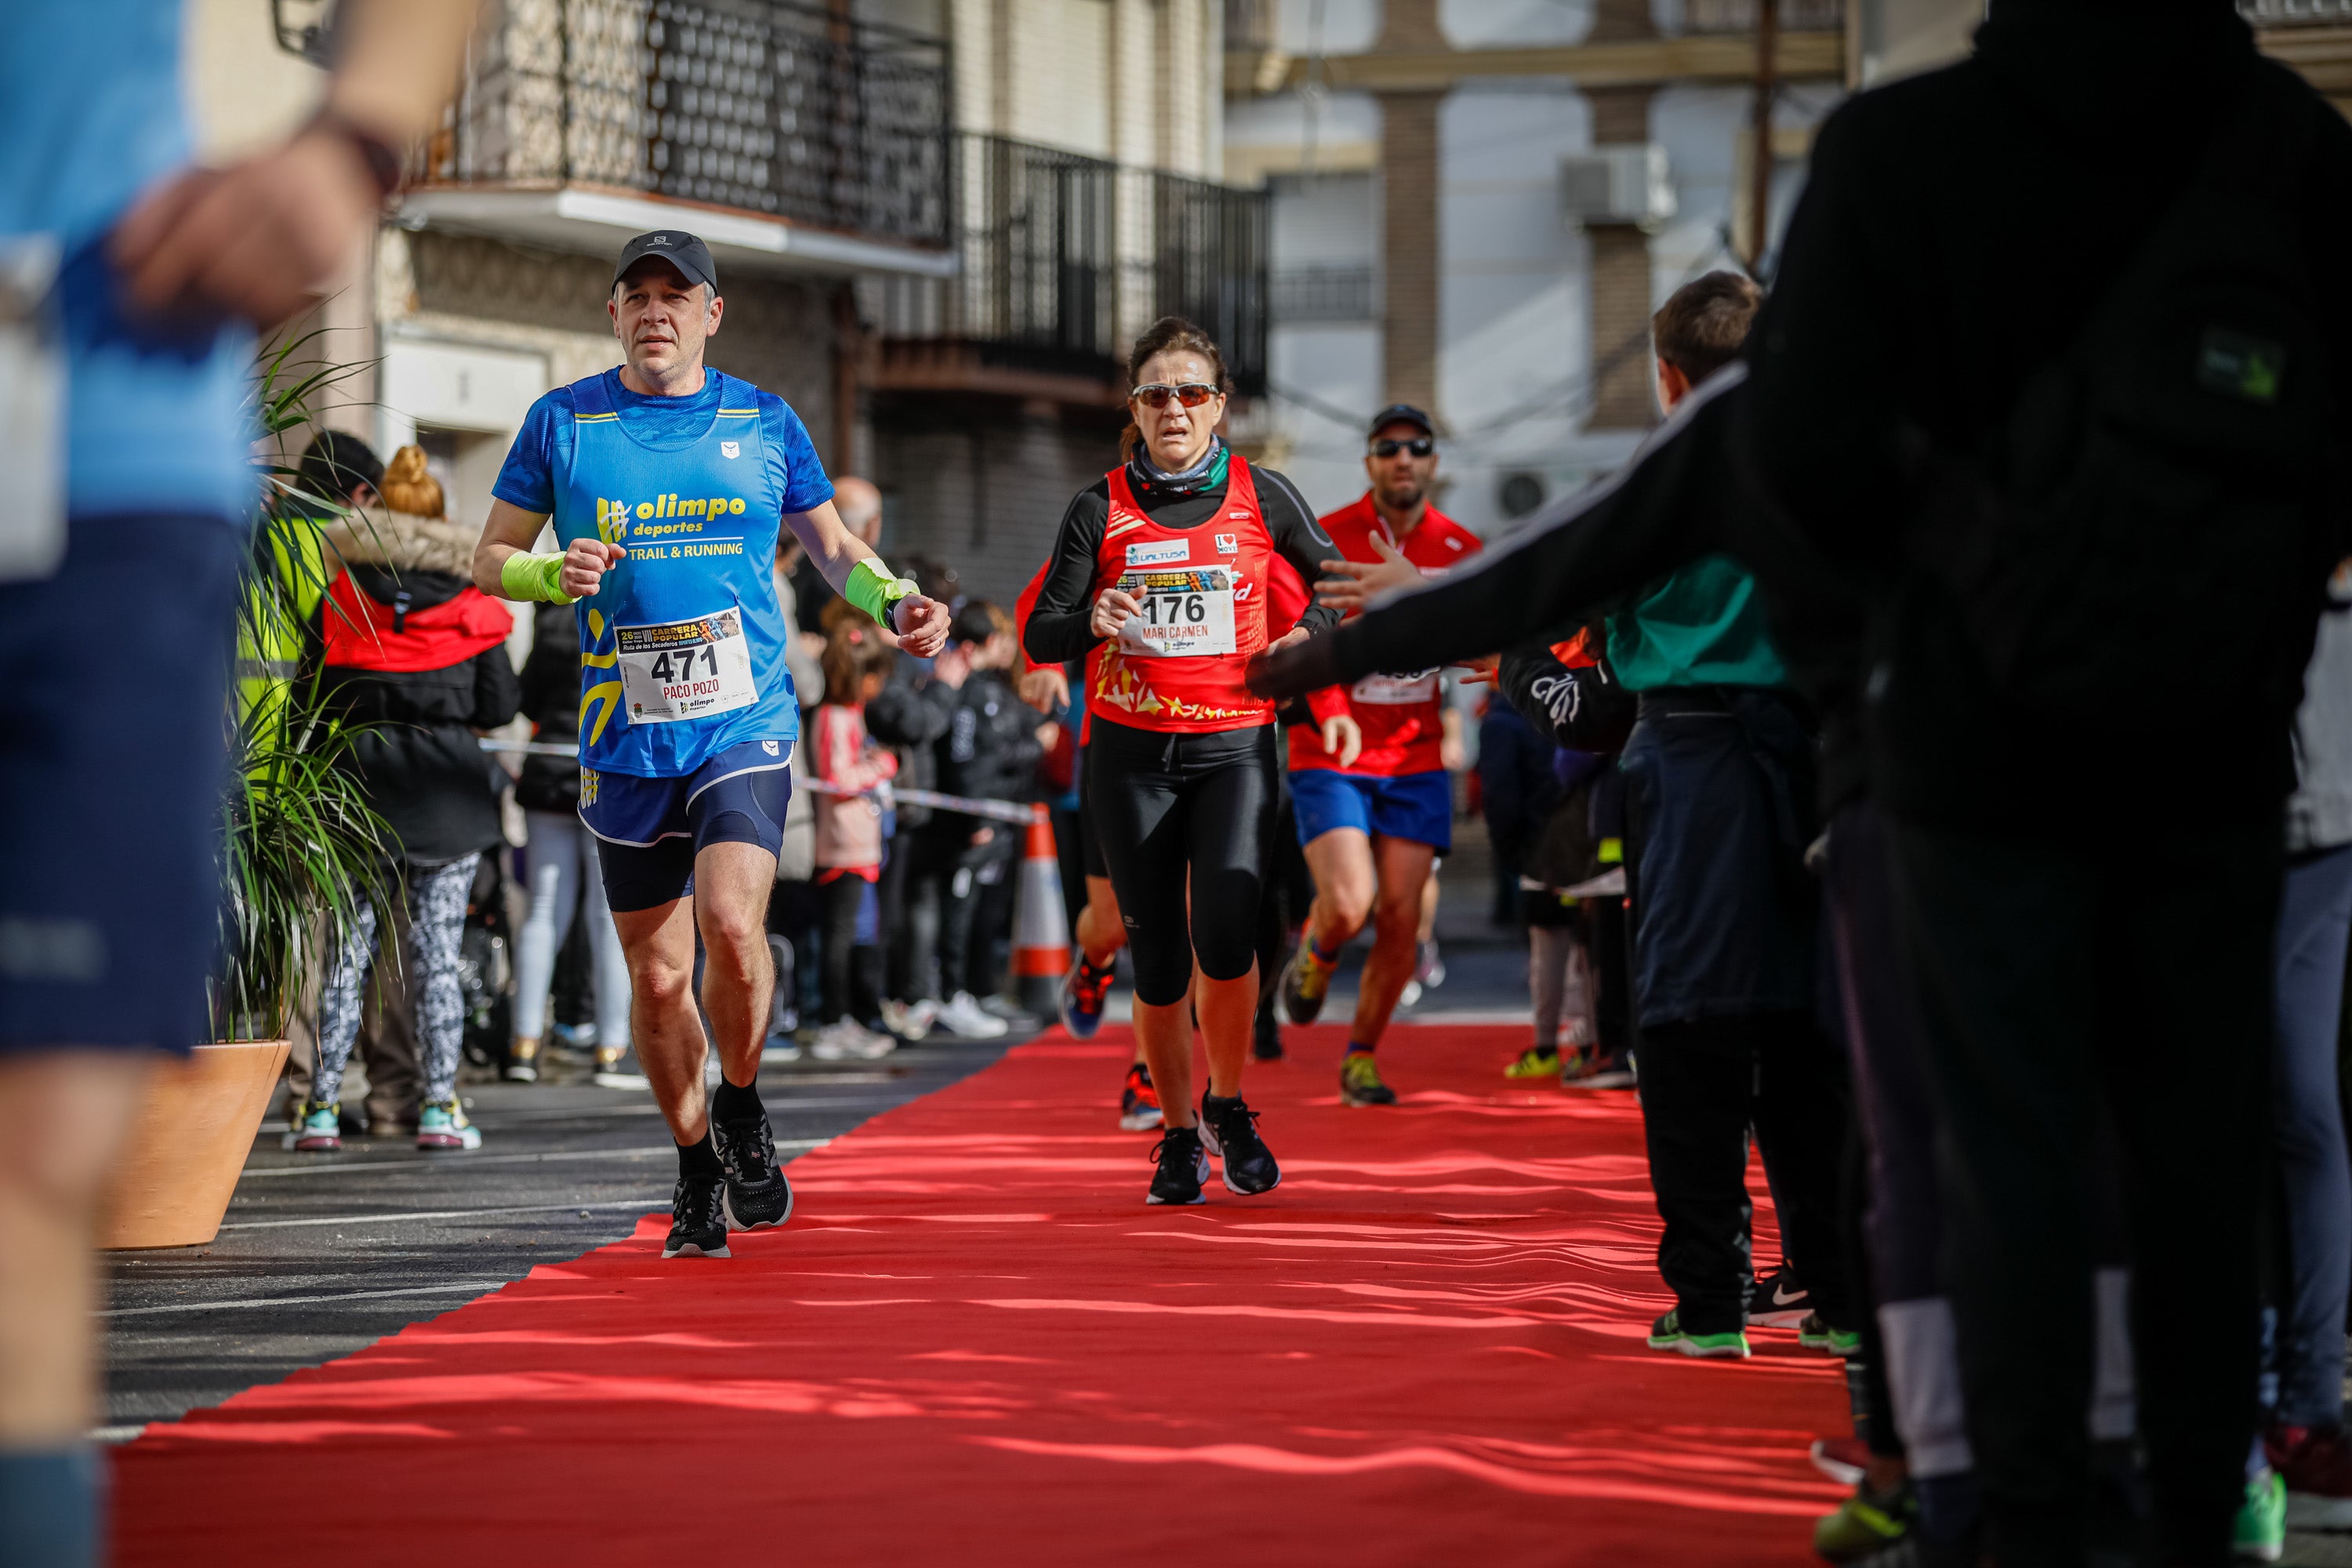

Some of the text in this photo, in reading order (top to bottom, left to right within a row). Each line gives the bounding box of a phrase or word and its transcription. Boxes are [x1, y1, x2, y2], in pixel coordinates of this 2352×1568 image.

[636, 493, 746, 521] olimpo
[633, 522, 703, 538] deportes
[629, 543, 743, 561] TRAIL & RUNNING
[1143, 594, 1205, 625] 176
[621, 631, 633, 641] 26
[652, 624, 698, 636] CARRERA
[653, 632, 699, 642] POPULAR
[1142, 625, 1208, 639] MARI CARMEN
[651, 644, 718, 684] 471
[663, 679, 720, 700] PACO POZO
